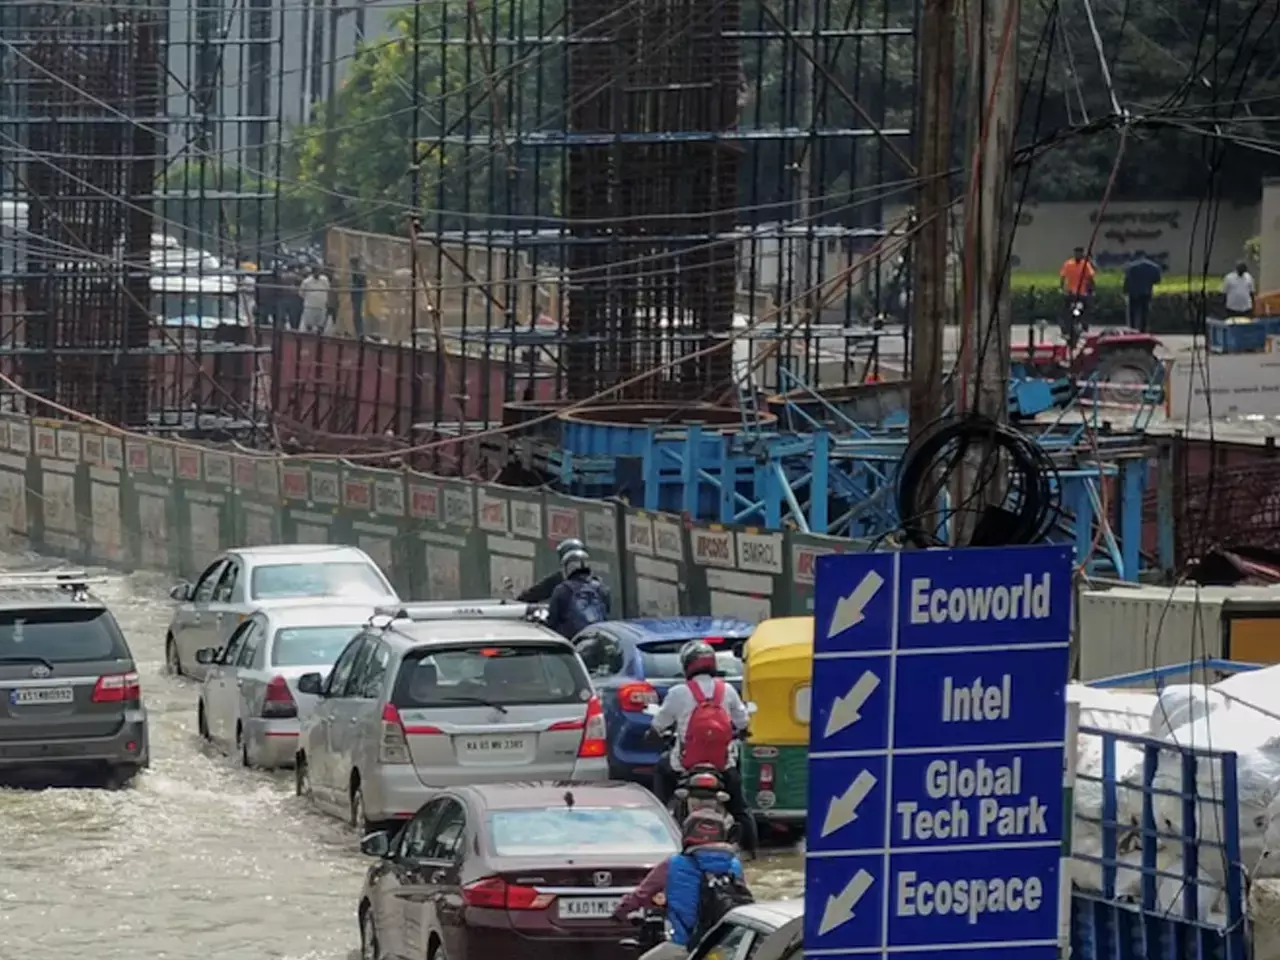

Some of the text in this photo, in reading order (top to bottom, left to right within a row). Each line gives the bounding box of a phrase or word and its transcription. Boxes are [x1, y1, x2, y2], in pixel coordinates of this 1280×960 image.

[910, 572, 1051, 624] Ecoworld
[942, 674, 1011, 722] Intel
[926, 757, 1021, 799] Global
[897, 796, 1047, 840] Tech Park
[897, 870, 1042, 924] Ecospace
